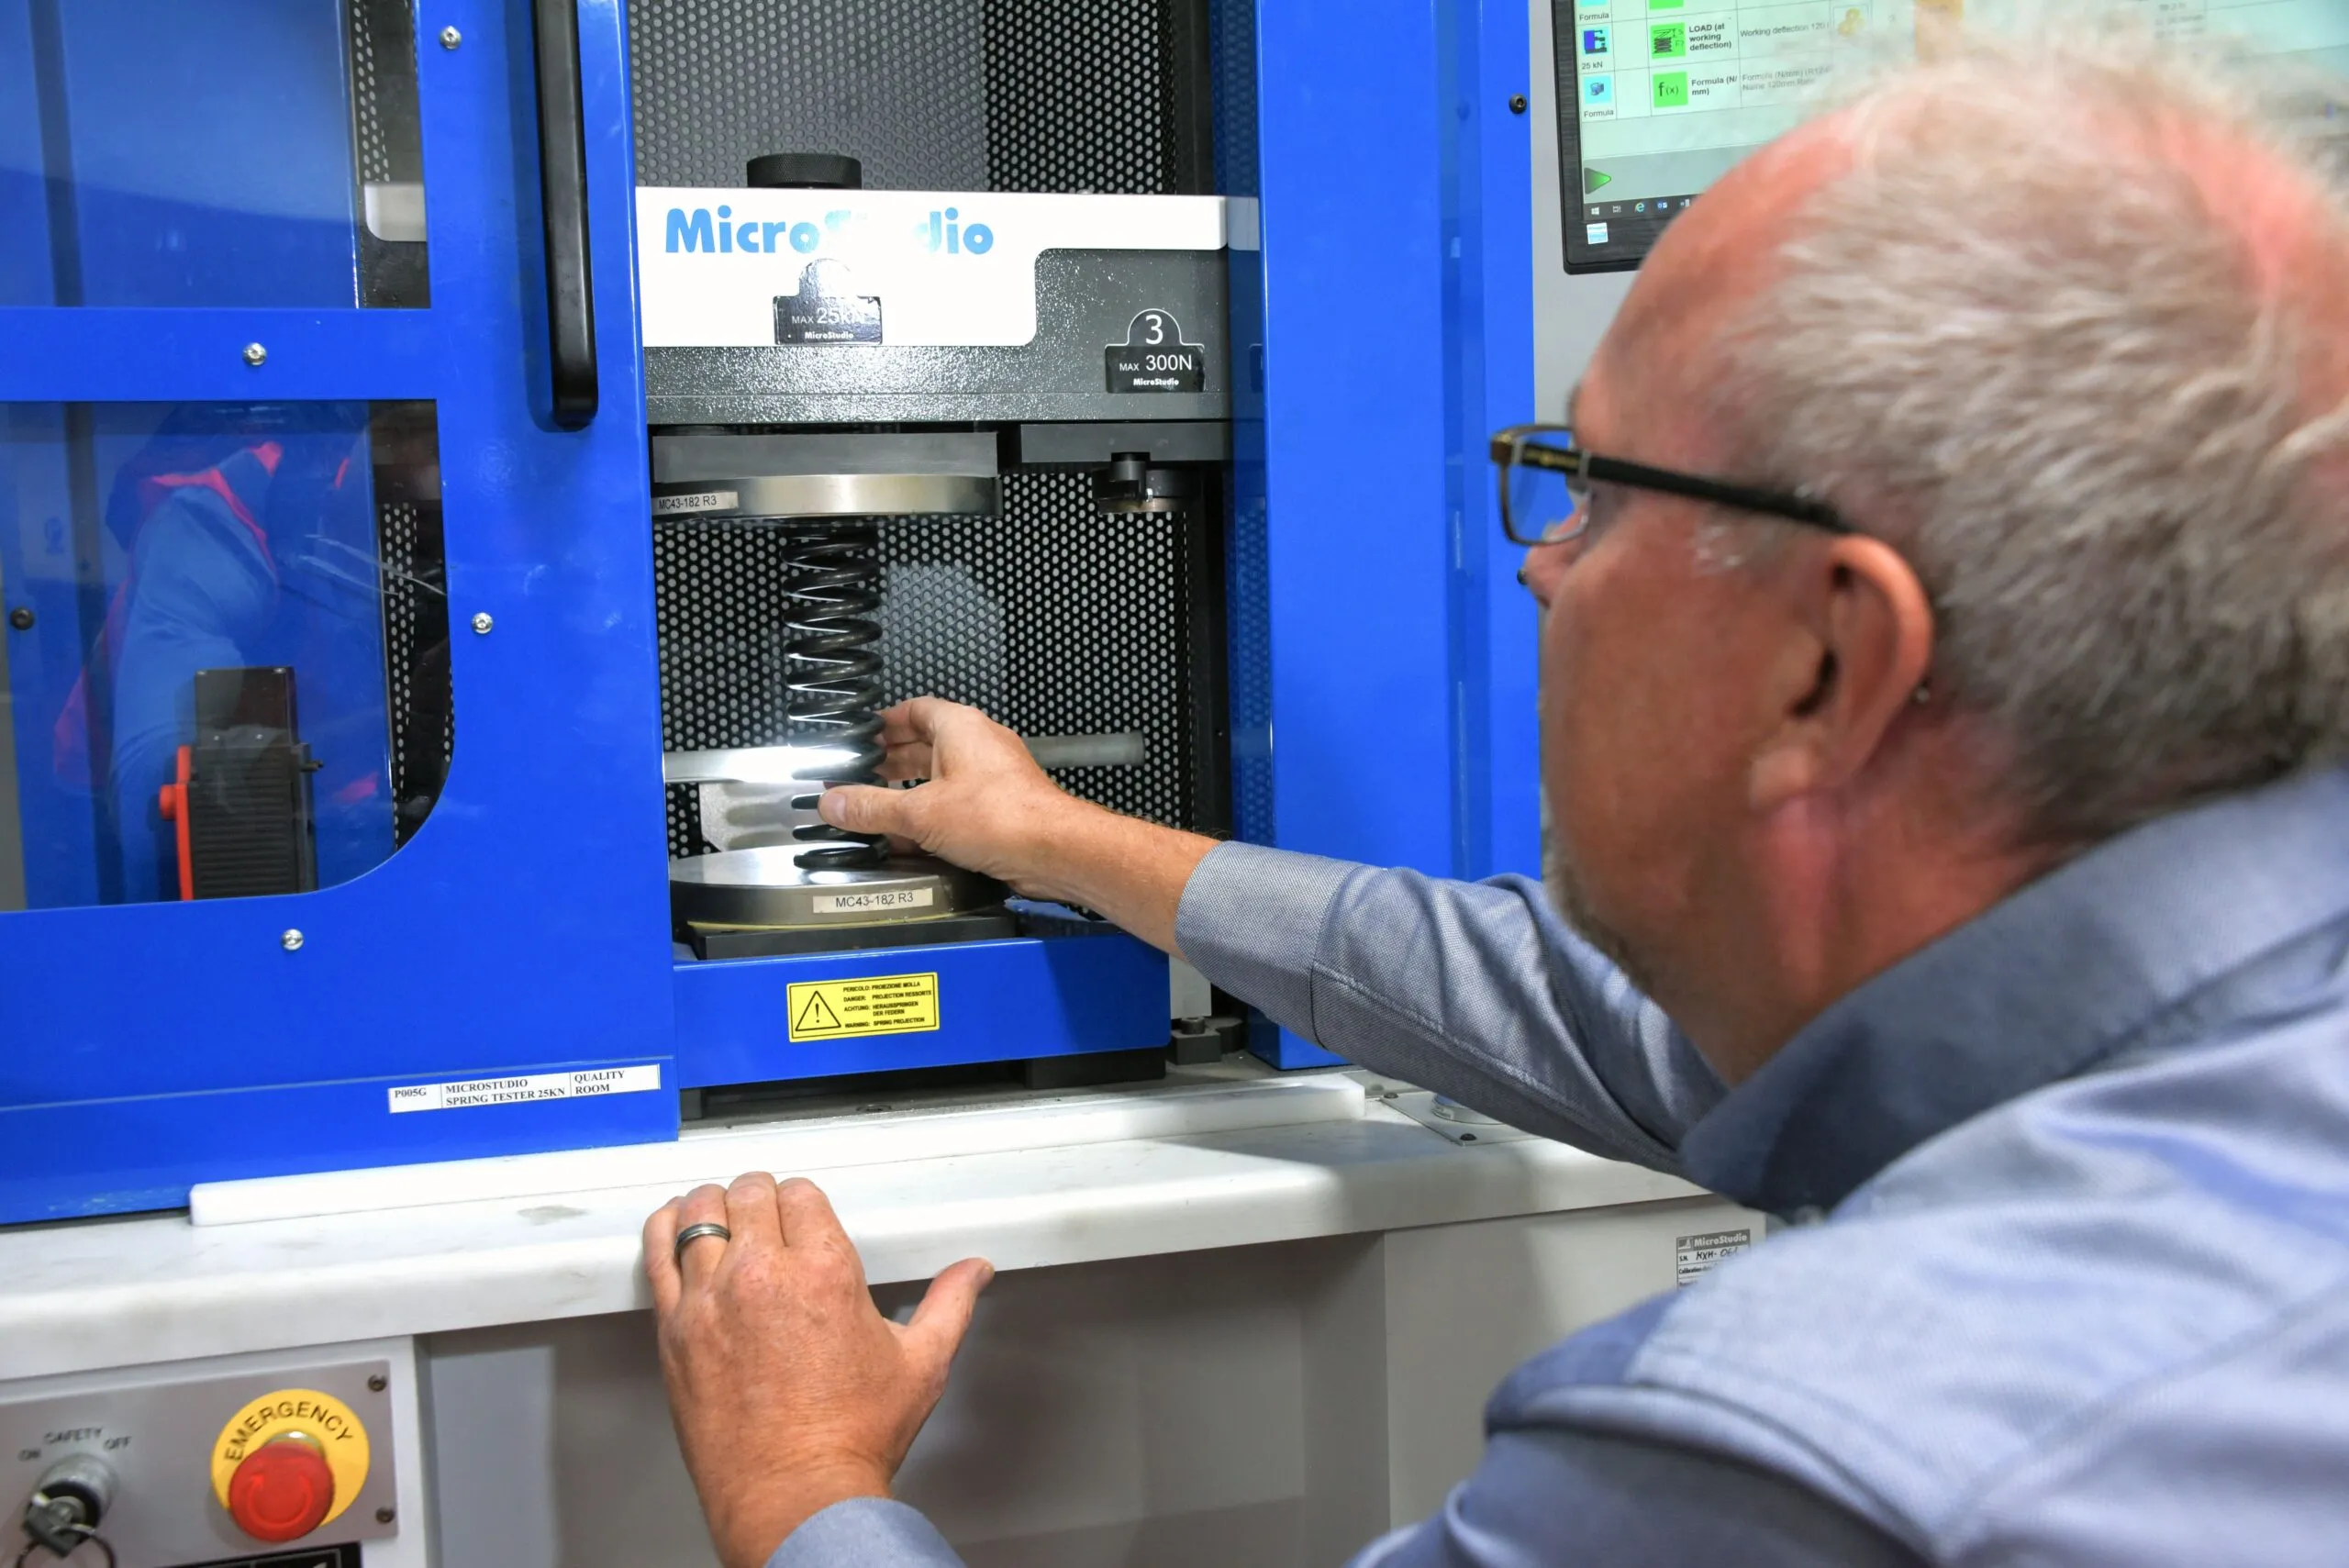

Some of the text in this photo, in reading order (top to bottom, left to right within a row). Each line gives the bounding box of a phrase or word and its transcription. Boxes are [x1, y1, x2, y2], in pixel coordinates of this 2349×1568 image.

[1579, 13, 1609, 21] Formula
[1689, 23, 1725, 32] LOAD (at
[1740, 28, 1771, 37] Working
[1773, 24, 1809, 34] deflection
[1689, 33, 1721, 41] working
[1689, 40, 1731, 50] deflection)
[1592, 61, 1603, 69] kN
[1691, 75, 1738, 86] Formula (N/
[1691, 88, 1709, 96] mm)
[1584, 109, 1614, 117] Formula
[665, 205, 994, 254] Microdio
[792, 316, 814, 324] MAX
[805, 331, 854, 339] MicroStudio
[1145, 314, 1163, 344] 3
[1119, 354, 1192, 372] MAX 300N
[1133, 377, 1180, 386] MicroStudio
[659, 495, 717, 510] MC43-182 R3
[835, 892, 914, 907] MC43-182 R3
[574, 1071, 625, 1084] QUALITY
[394, 1087, 427, 1098] P005G
[446, 1079, 529, 1094] MICROSTUDIO
[575, 1084, 610, 1095] ROOM
[446, 1087, 565, 1106] SPRING TESTER 25KN
[1694, 1233, 1747, 1247] MicroStudio
[44, 1427, 103, 1445] SAFETY
[225, 1401, 353, 1461] EMERGENCY
[103, 1436, 132, 1451] OFF
